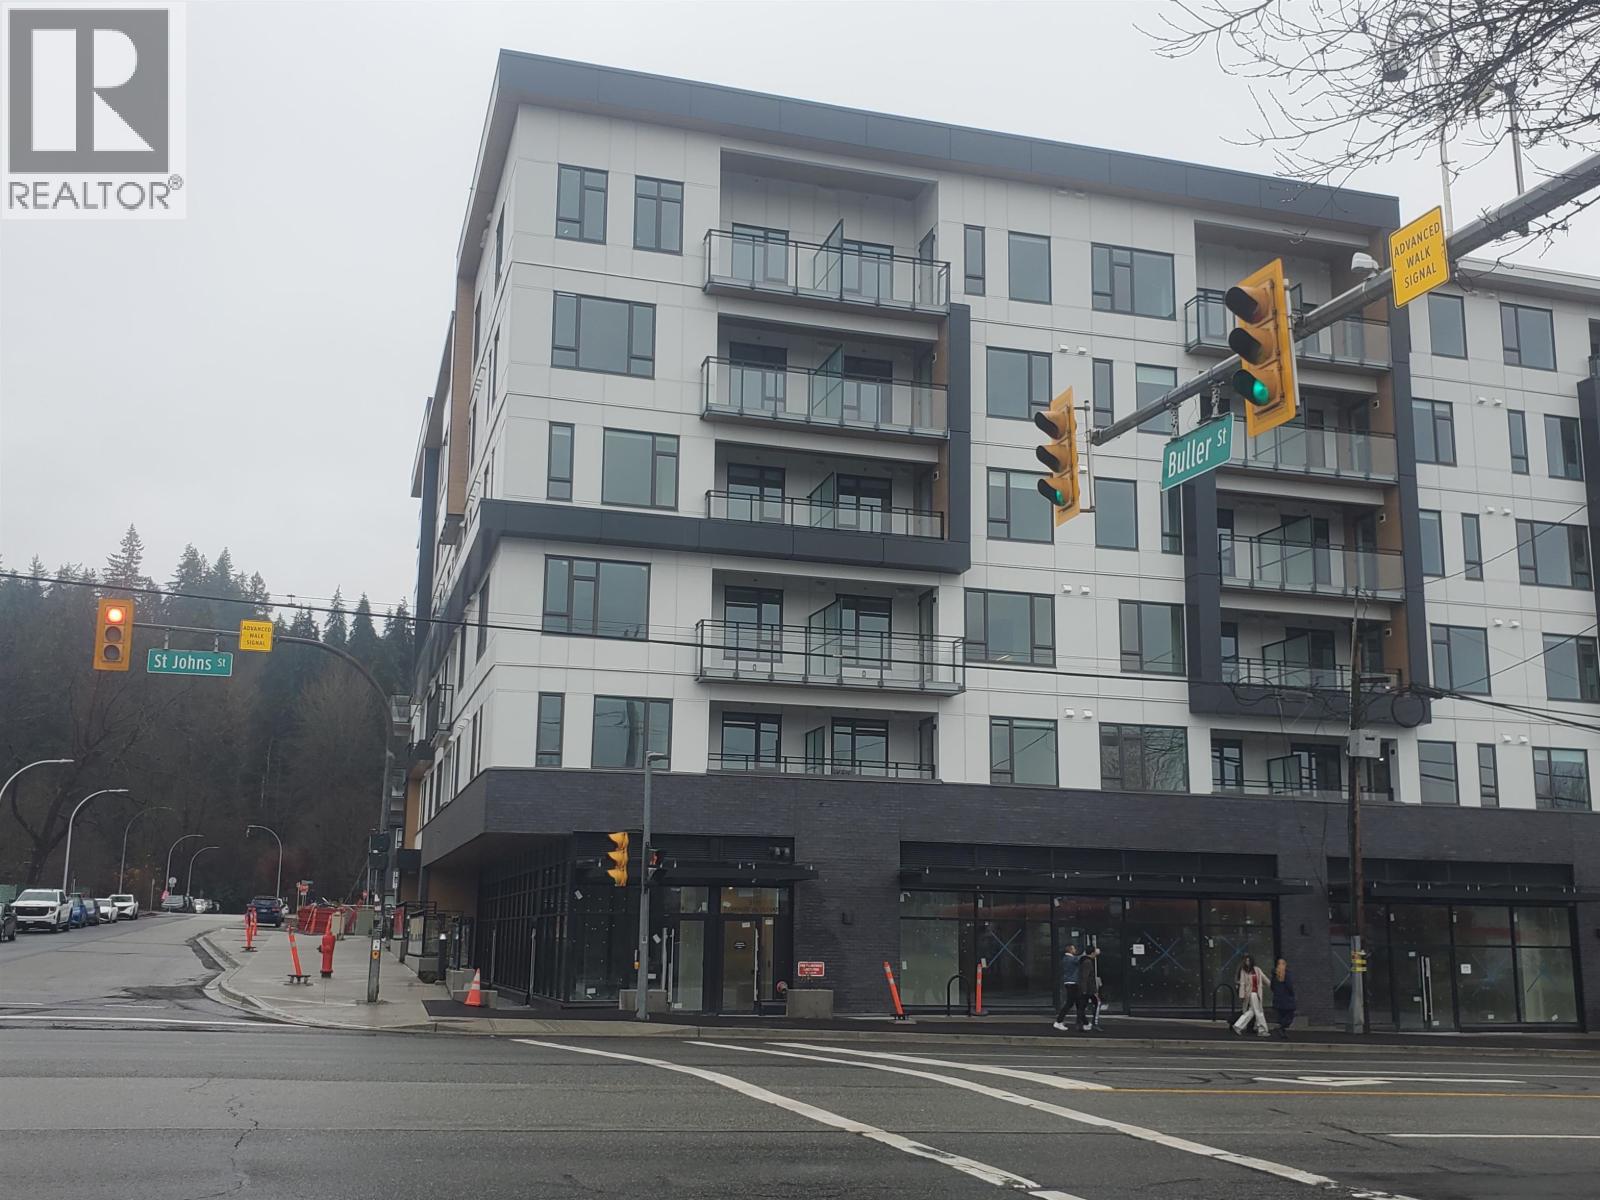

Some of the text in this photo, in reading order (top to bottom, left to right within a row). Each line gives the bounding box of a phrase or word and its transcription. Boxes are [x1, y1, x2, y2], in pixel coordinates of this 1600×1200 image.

[1393, 222, 1440, 258] ADVANCED
[1406, 245, 1431, 269] WALK
[1404, 262, 1437, 289] SIGNAL
[1168, 427, 1227, 479] Buller St
[243, 625, 272, 633] ADVANCED
[154, 654, 226, 671] St Johns St
